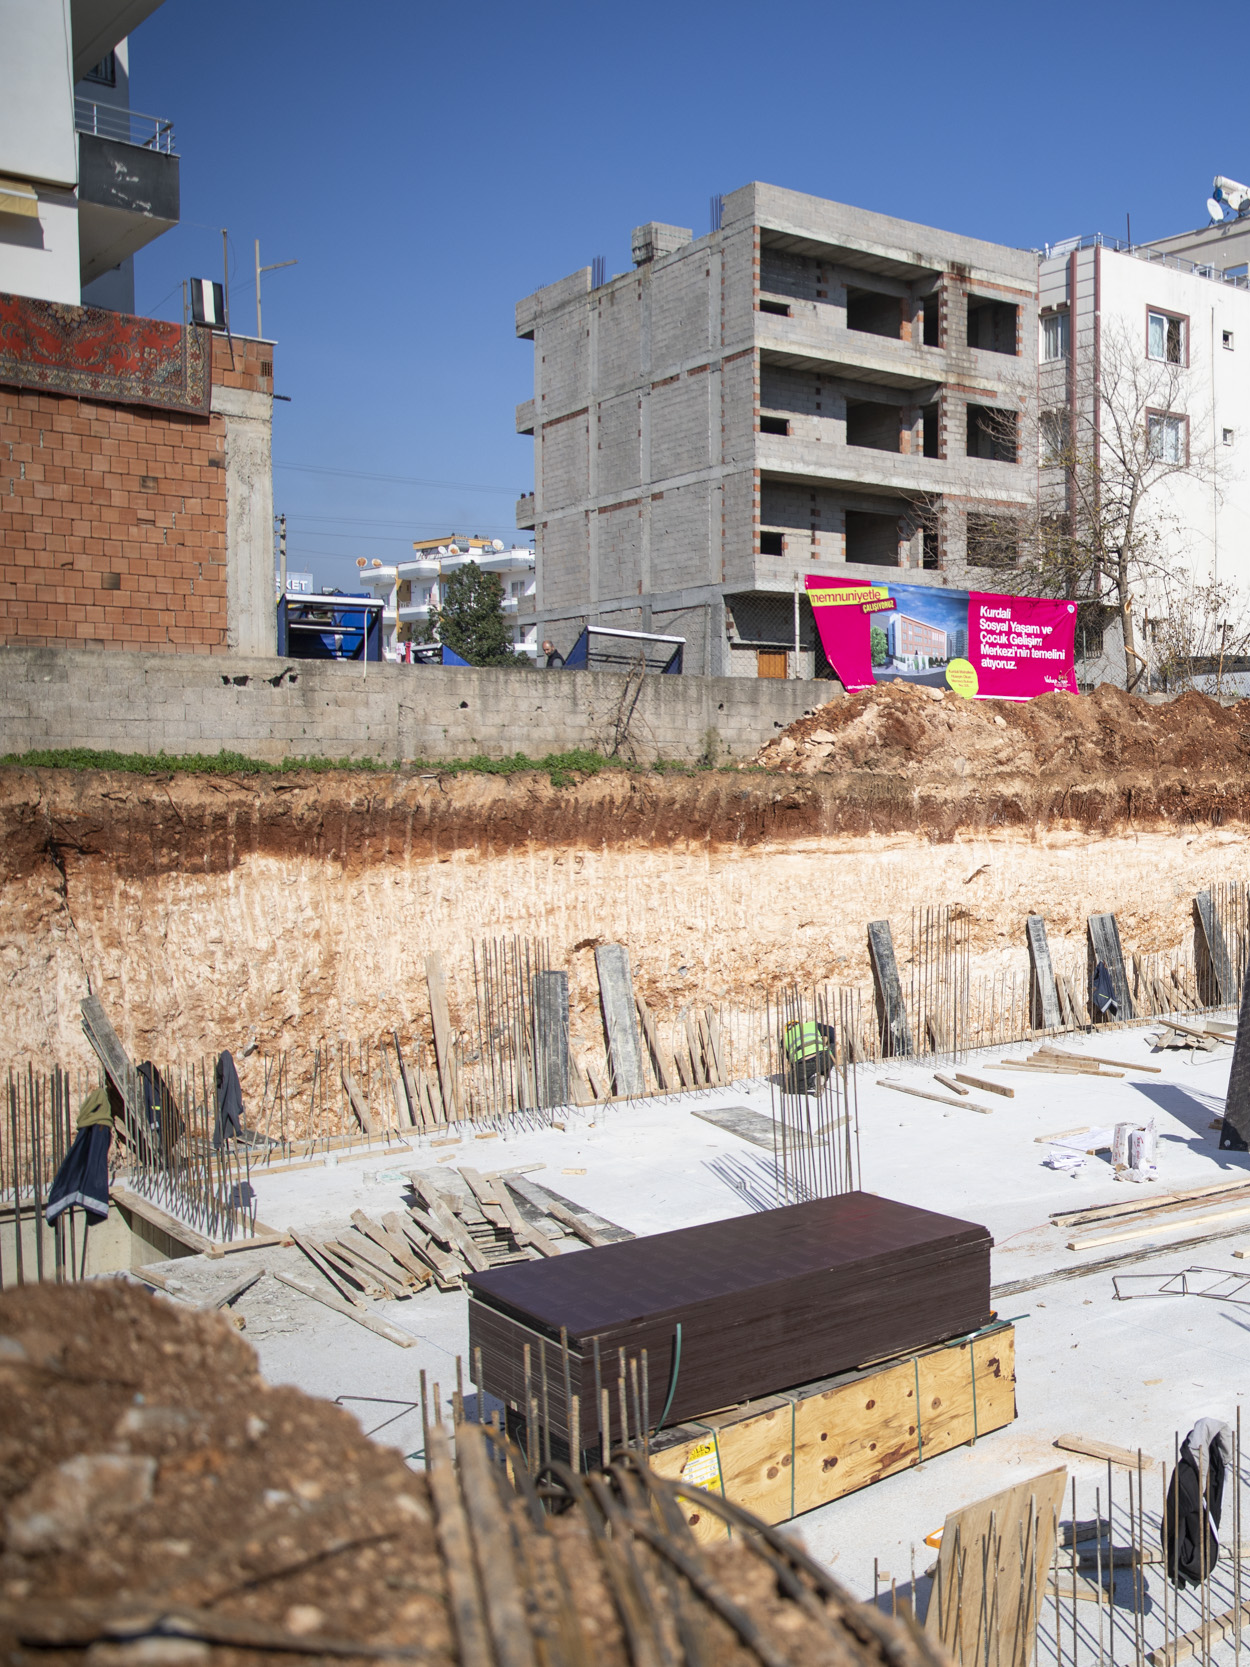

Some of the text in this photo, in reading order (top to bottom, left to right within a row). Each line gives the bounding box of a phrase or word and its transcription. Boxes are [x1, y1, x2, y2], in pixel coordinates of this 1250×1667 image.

[811, 589, 881, 605] memnuniyetle
[980, 605, 1011, 619] Kurdali
[979, 618, 1053, 635] Sosyal Yaşam ve
[980, 631, 1043, 648] Çocuk Gelişim
[1031, 647, 1066, 660] temelini
[981, 657, 1017, 670] atıyoruz.
